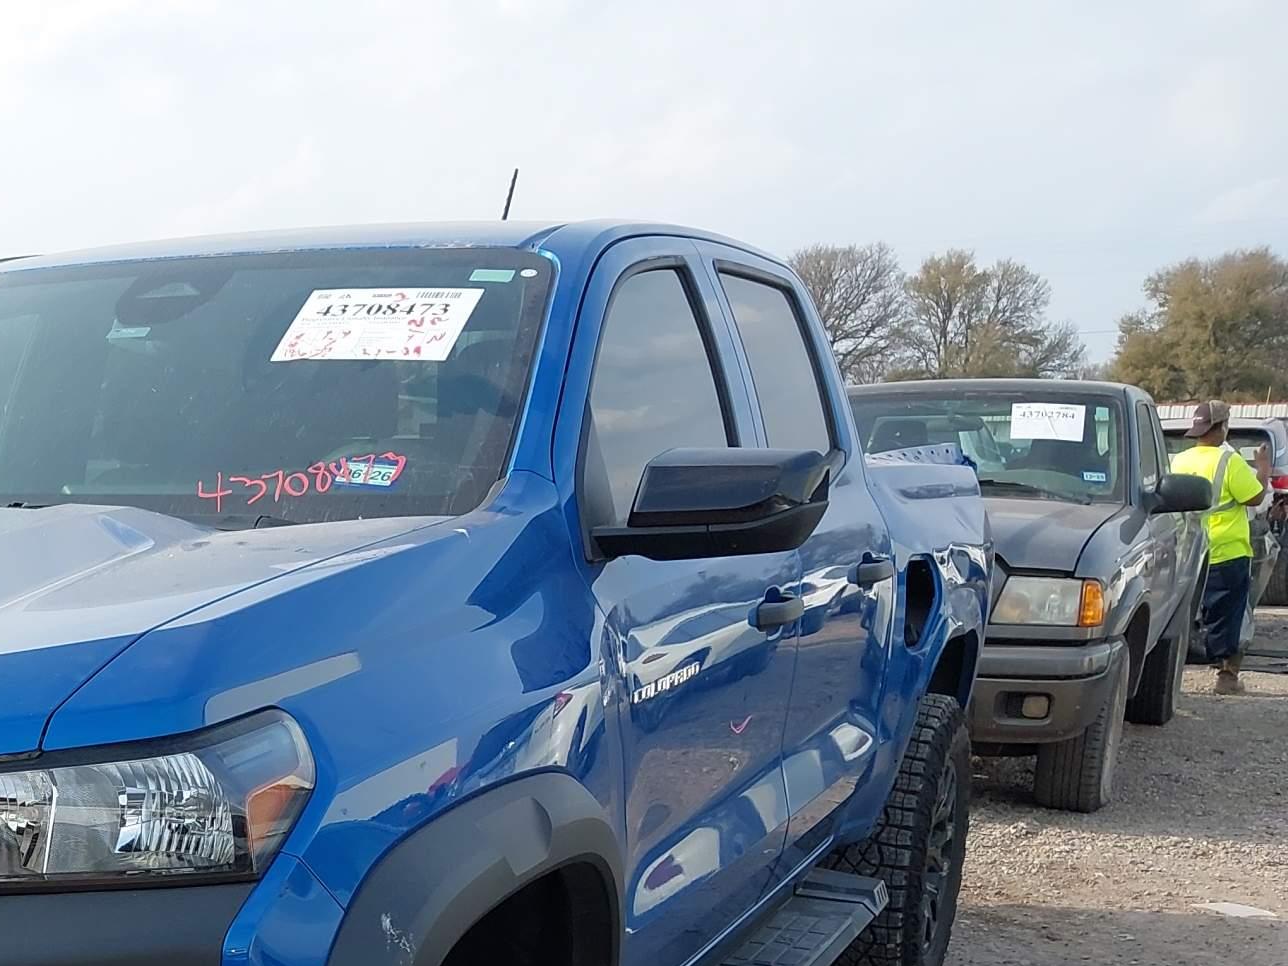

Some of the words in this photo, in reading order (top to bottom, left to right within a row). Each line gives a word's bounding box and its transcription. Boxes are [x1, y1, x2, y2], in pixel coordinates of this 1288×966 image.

[316, 303, 450, 316] 43708473
[198, 452, 406, 512] 43708473
[633, 661, 700, 704] COLORADO
